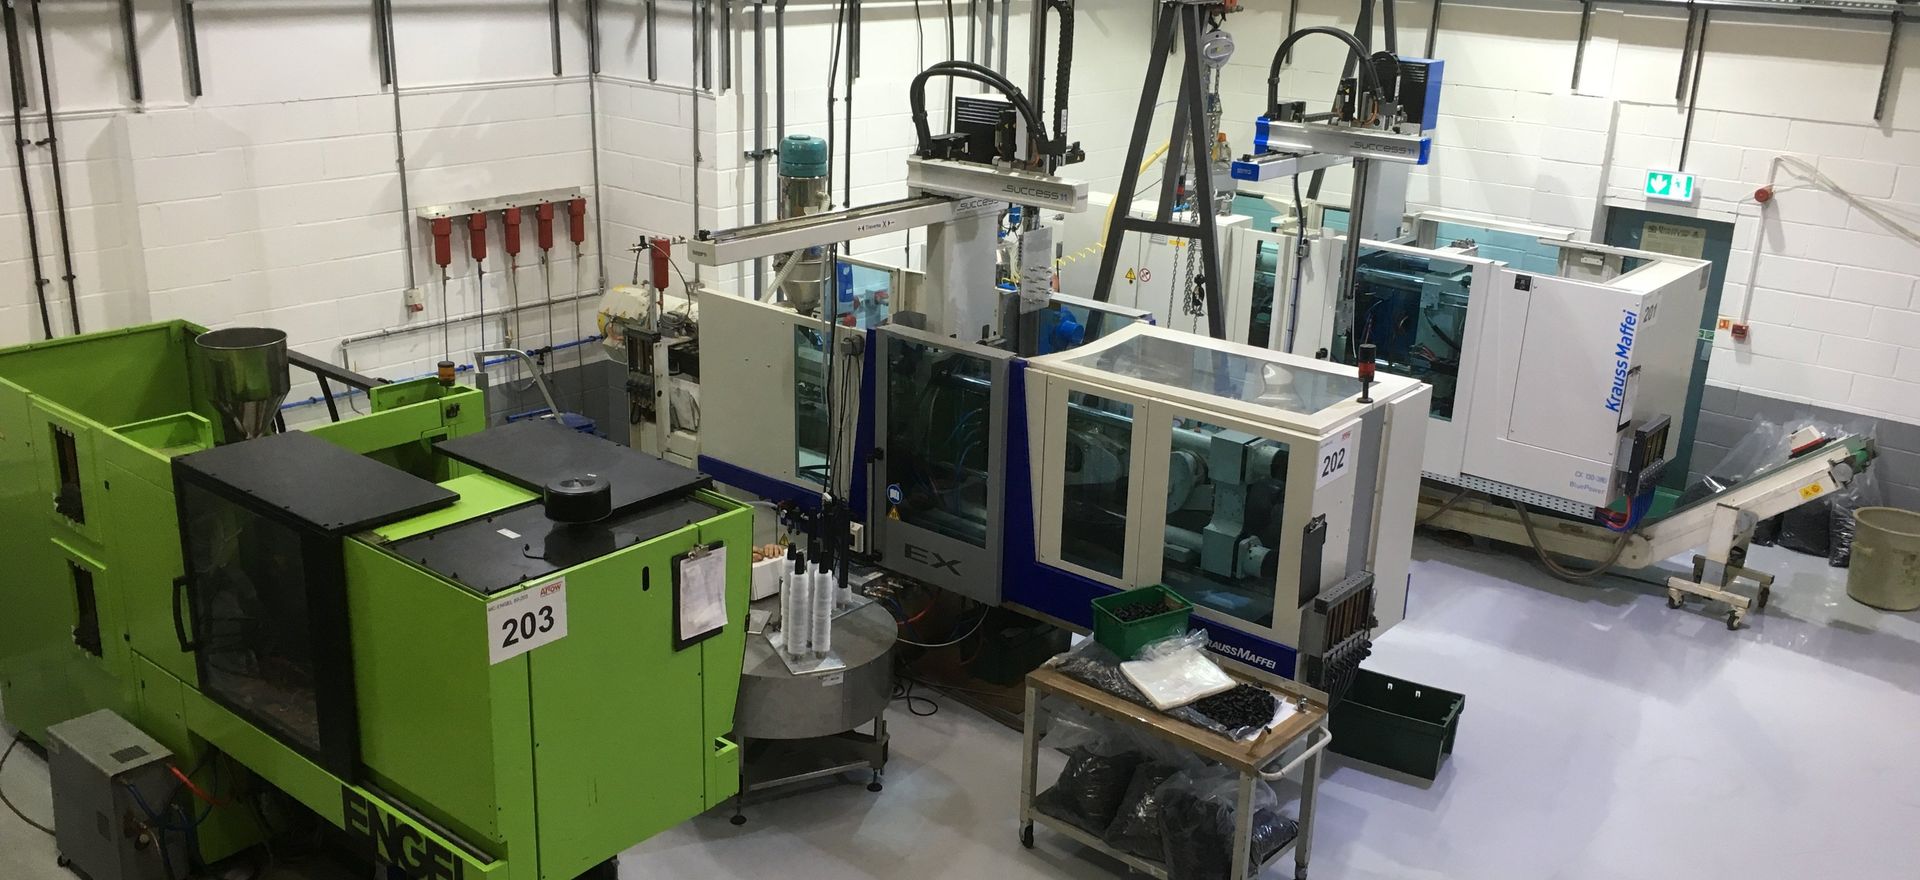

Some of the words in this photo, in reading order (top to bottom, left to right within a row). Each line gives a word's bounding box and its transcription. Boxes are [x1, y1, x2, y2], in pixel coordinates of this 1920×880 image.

[1642, 303, 1658, 323] 201
[1321, 447, 1346, 478] 202
[904, 543, 962, 577] EX
[502, 605, 555, 648] 203
[1206, 640, 1277, 670] RAUSSMAFFEI
